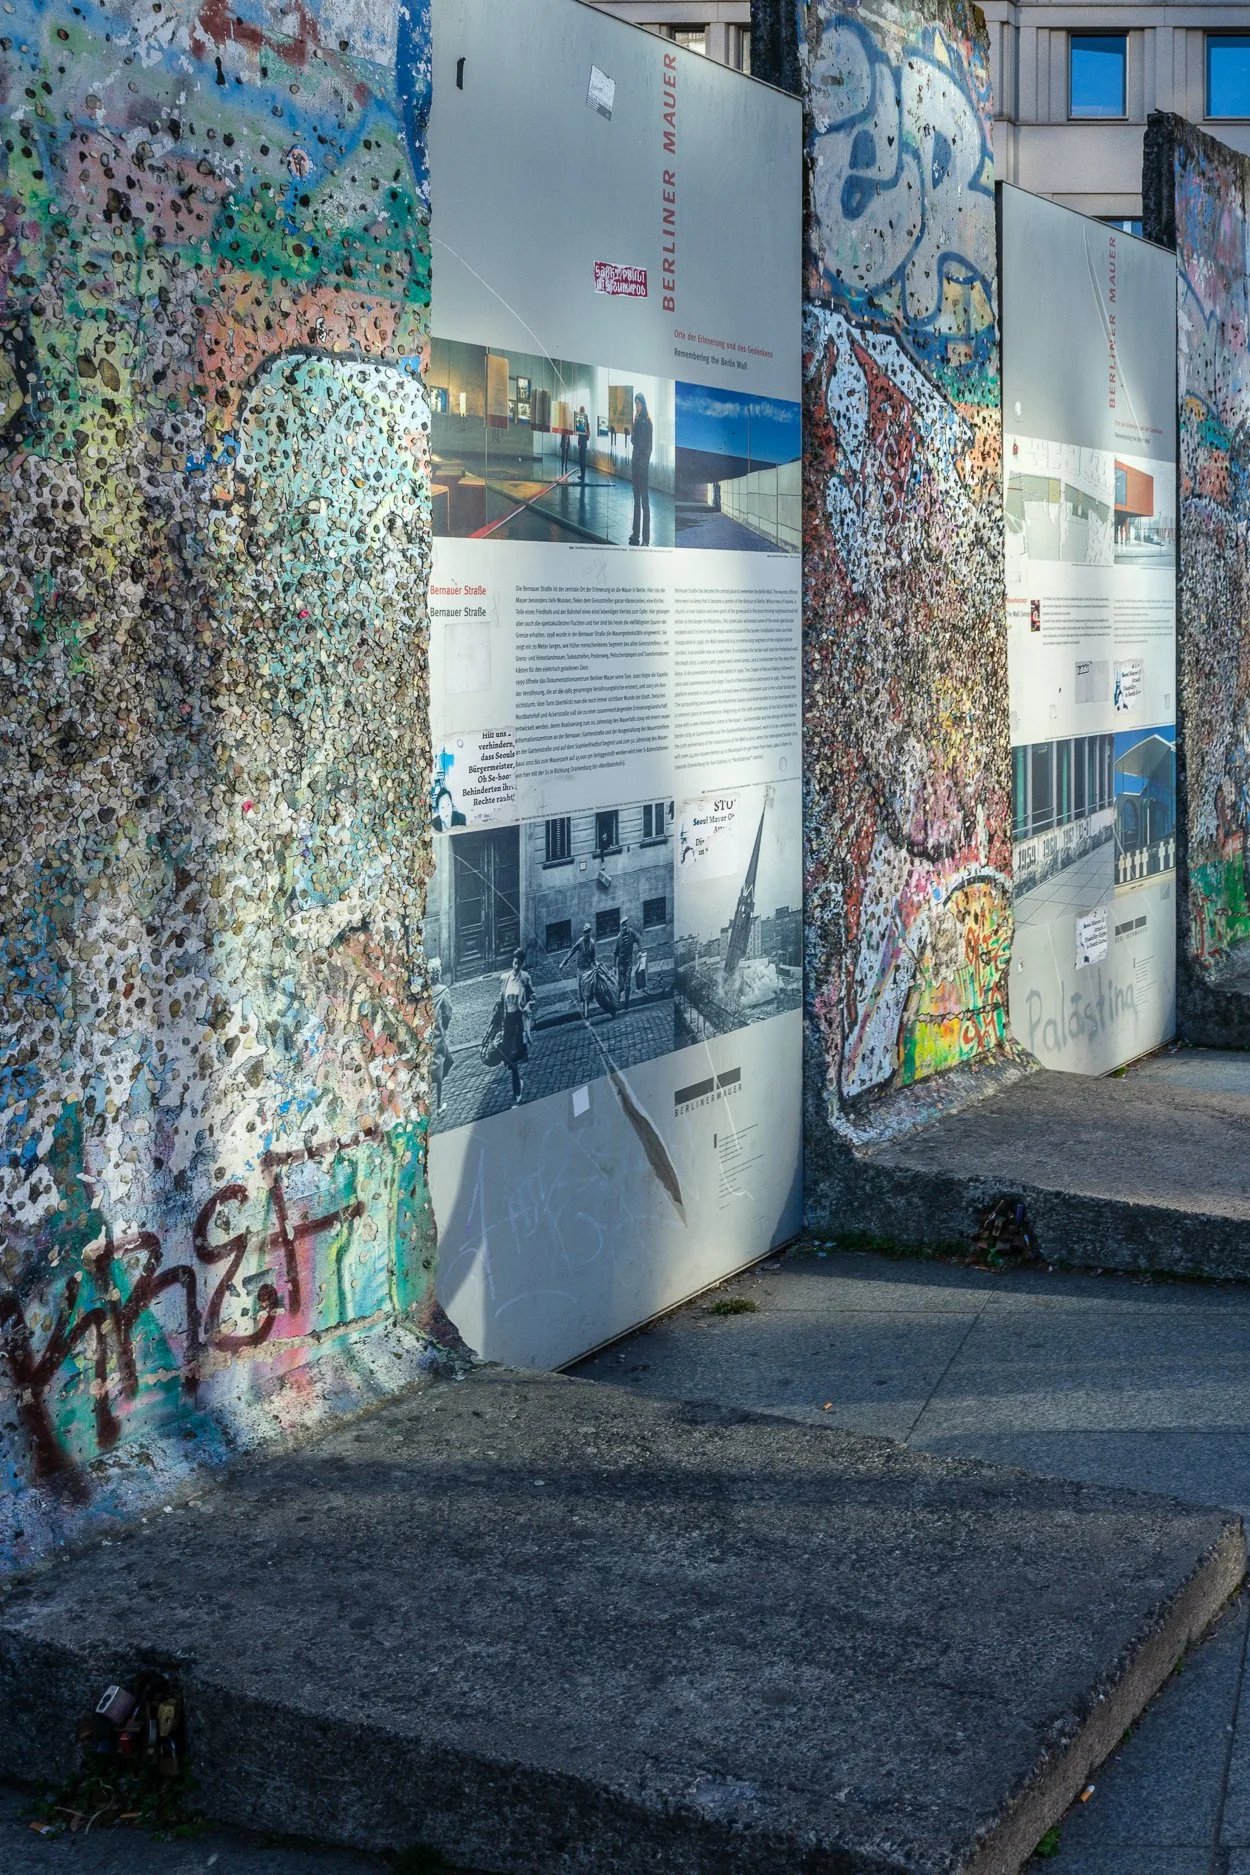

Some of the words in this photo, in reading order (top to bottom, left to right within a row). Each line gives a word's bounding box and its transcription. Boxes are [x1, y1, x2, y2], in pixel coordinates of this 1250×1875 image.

[663, 53, 677, 155] MAUER
[663, 170, 676, 312] BERLINER
[1109, 236, 1117, 304] MAUER
[674, 329, 686, 340] Orte
[687, 332, 696, 341] der
[430, 585, 462, 595] Bernauer
[464, 585, 487, 595] Straße
[430, 607, 462, 616] Bernauer
[464, 606, 487, 616] Straße
[481, 752, 494, 761] dass
